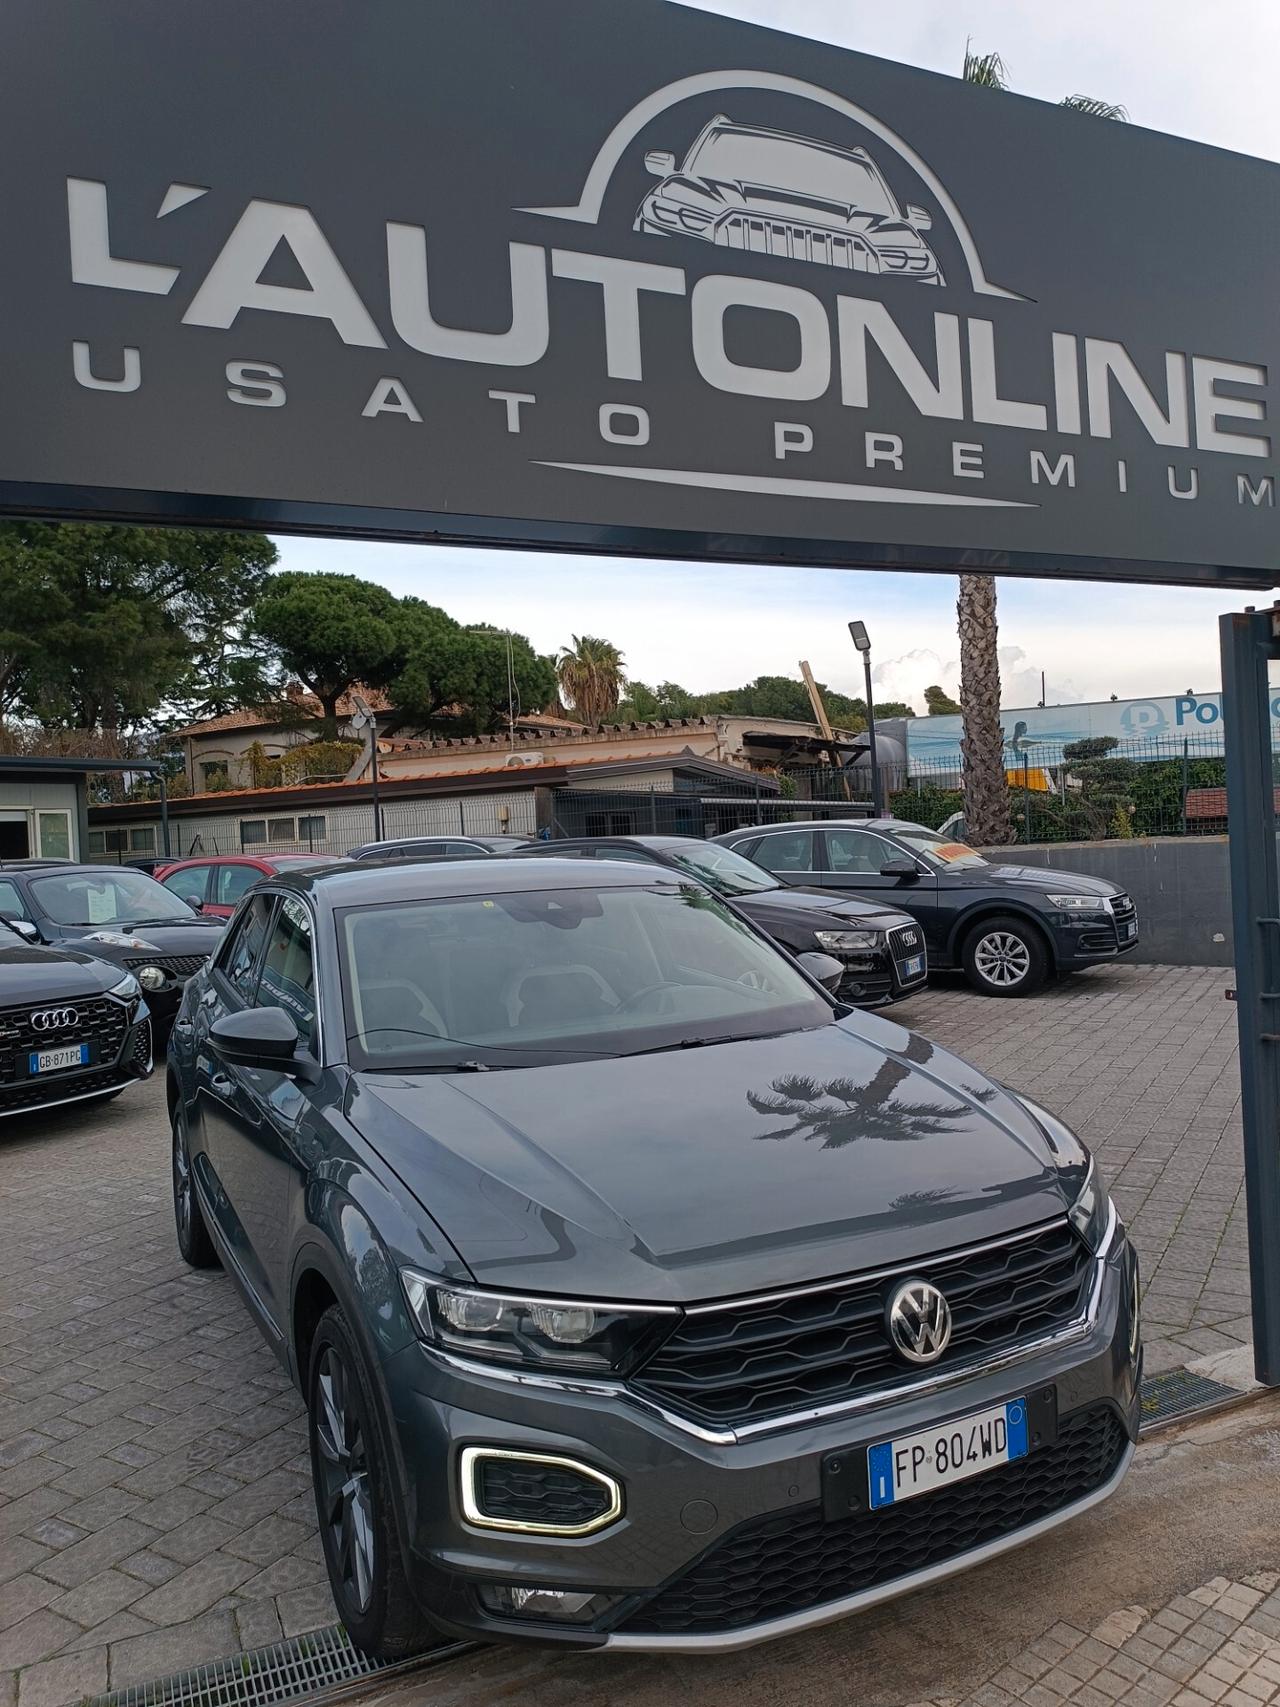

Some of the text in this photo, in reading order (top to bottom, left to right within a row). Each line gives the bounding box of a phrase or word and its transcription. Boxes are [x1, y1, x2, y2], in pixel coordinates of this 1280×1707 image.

[66, 175, 1270, 457] L'AUTONLINE
[73, 340, 1274, 507] USATO PREMIUM
